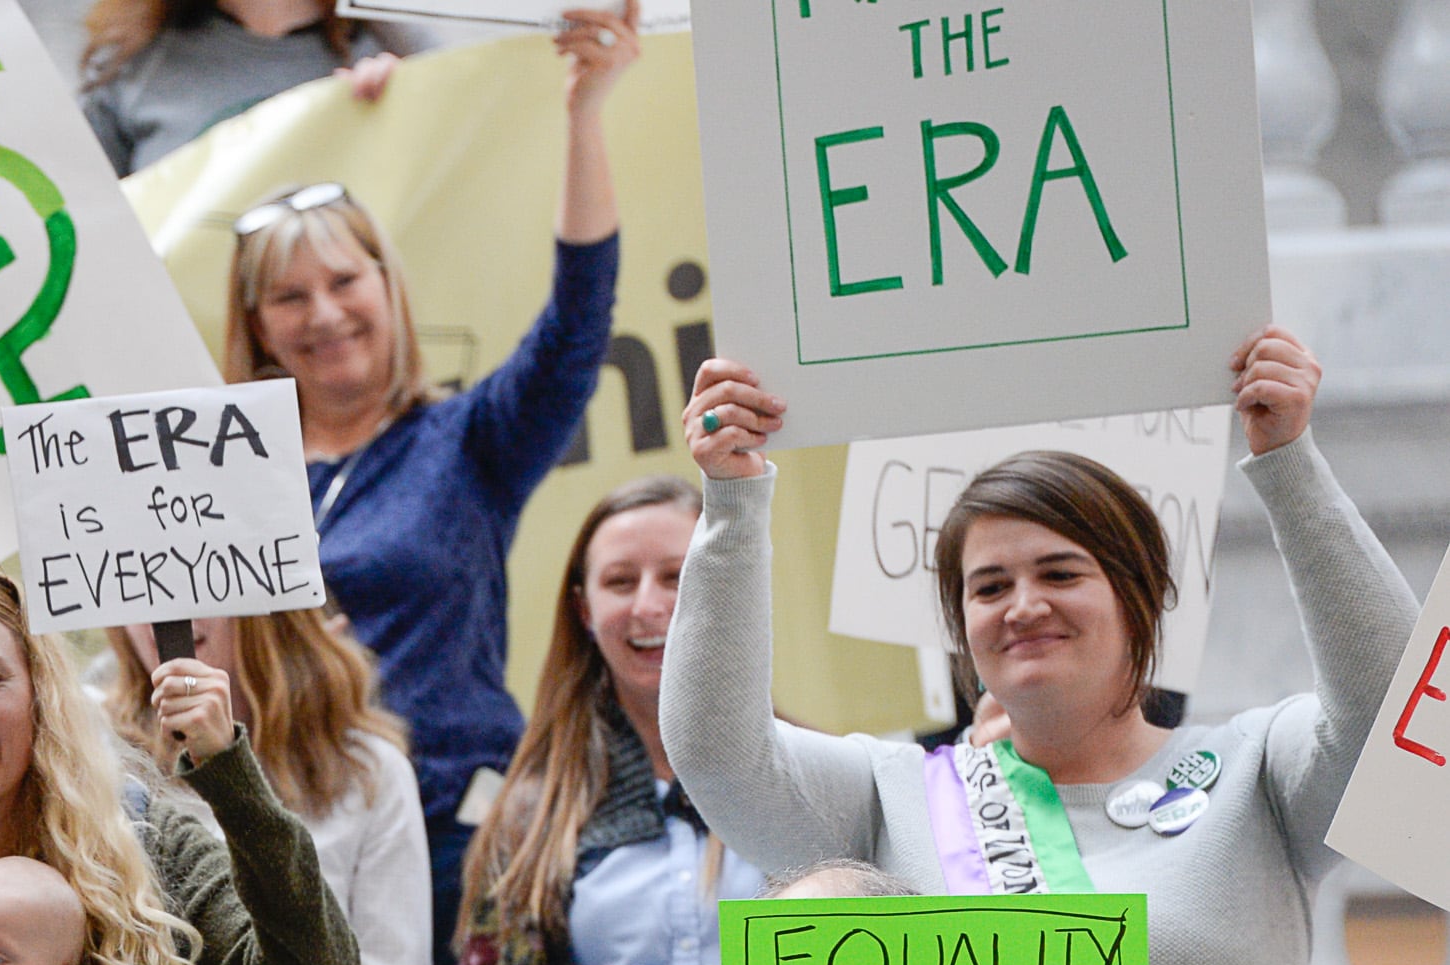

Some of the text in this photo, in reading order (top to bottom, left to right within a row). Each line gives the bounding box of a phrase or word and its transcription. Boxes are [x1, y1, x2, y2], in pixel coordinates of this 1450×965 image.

[898, 8, 1010, 79] THE
[814, 105, 1128, 297] ERA
[17, 403, 270, 475] The ERA
[59, 503, 104, 540] is
[37, 533, 319, 617] EVERYONE.
